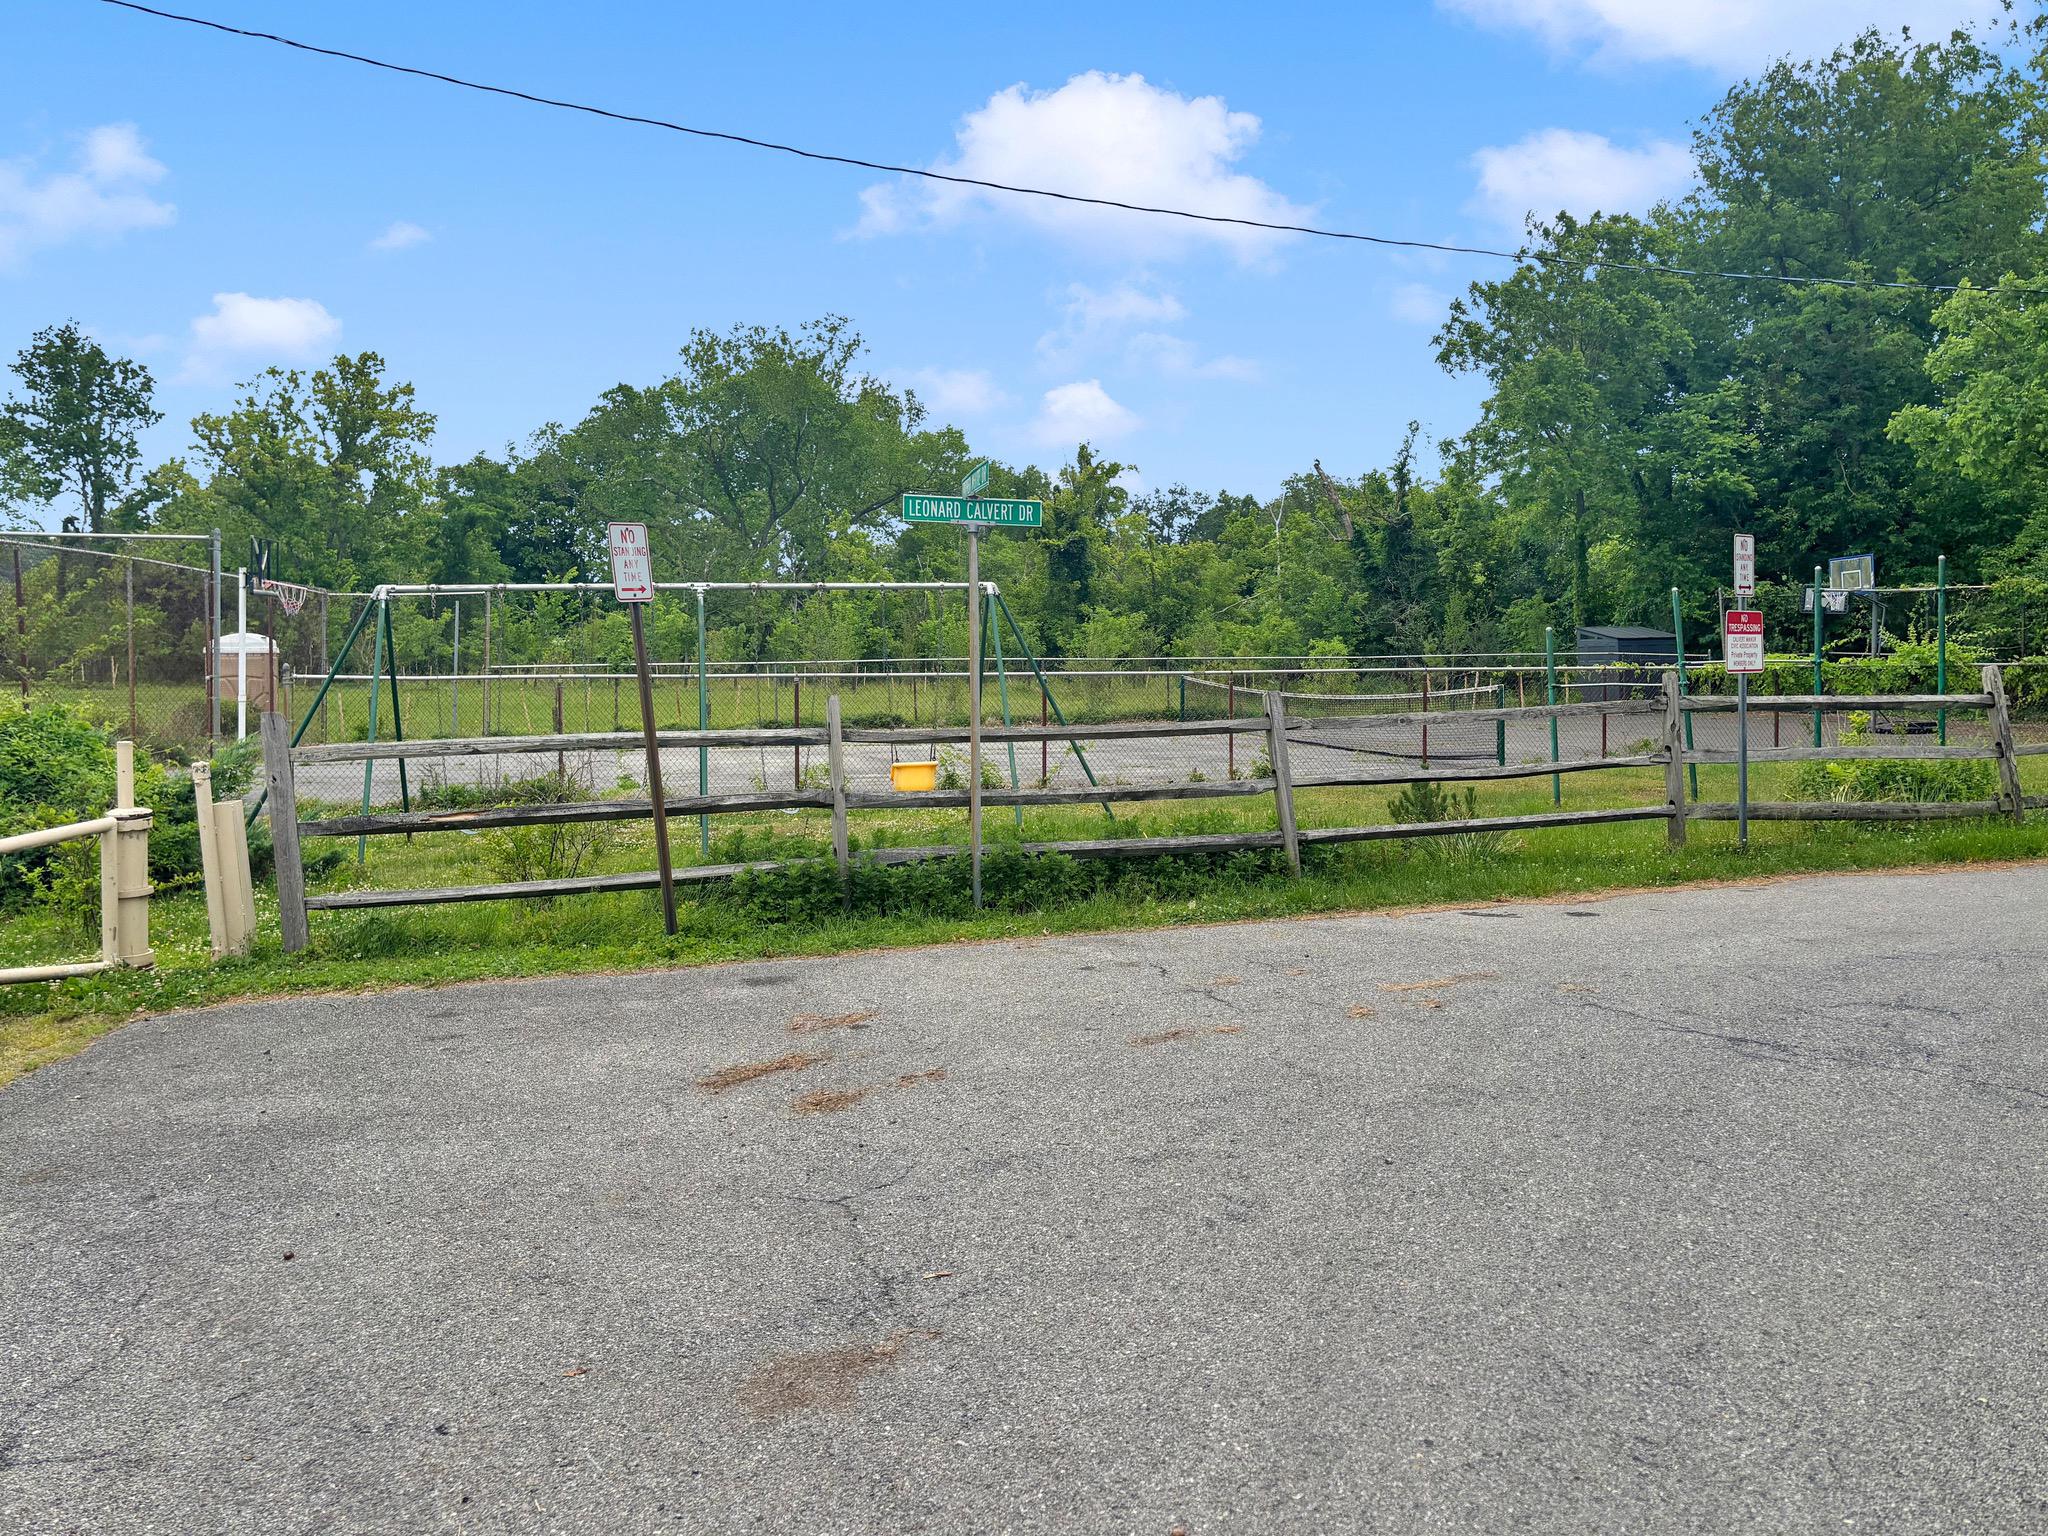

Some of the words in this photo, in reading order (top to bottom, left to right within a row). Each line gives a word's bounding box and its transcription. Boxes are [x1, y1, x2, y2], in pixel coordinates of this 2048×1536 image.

[909, 499, 961, 519] LEONARD
[966, 502, 1014, 520] CALVERT
[1019, 504, 1033, 522] DR
[620, 529, 635, 544] NO
[1740, 539, 1749, 551] NO
[624, 559, 639, 569] ANY
[624, 572, 642, 582] TIME
[1740, 614, 1748, 623] NO
[1728, 624, 1761, 632] TRESPASSING
[1744, 652, 1758, 660] Property
